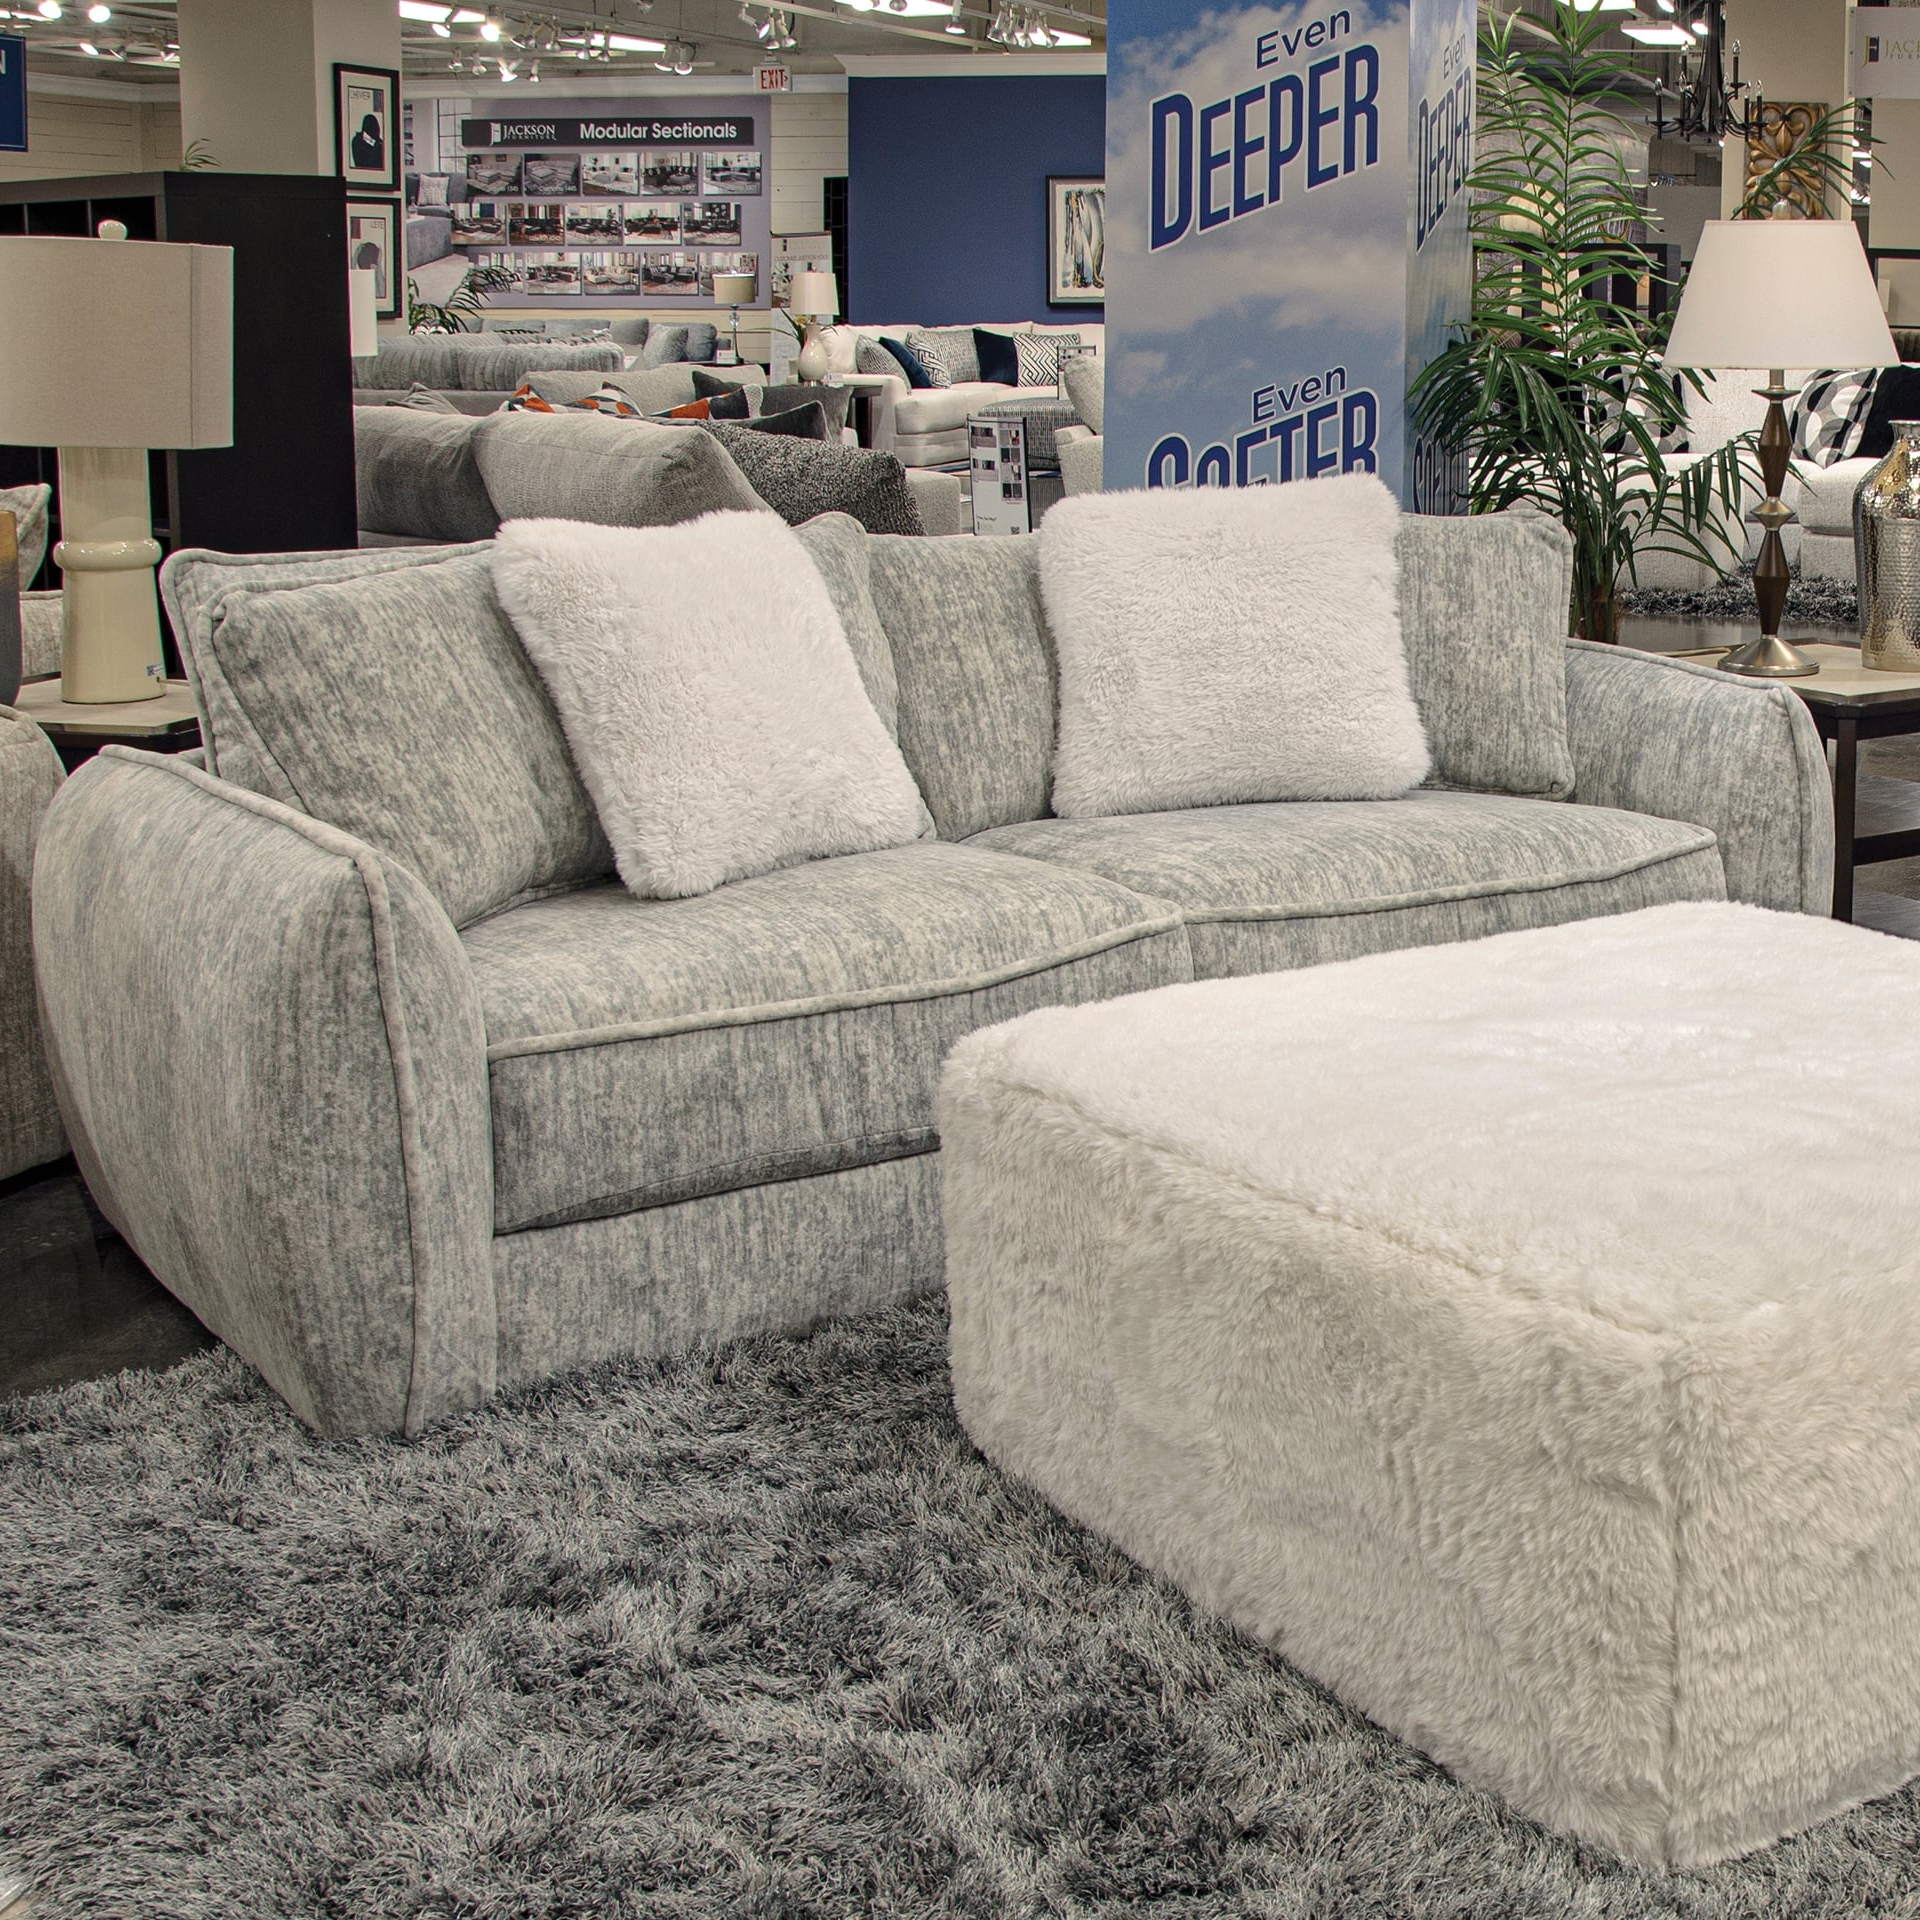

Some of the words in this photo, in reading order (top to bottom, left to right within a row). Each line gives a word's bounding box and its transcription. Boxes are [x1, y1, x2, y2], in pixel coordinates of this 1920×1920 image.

[1256, 10, 1351, 70] Even
[1443, 33, 1466, 81] Even
[760, 69, 785, 89] EXIT
[503, 124, 555, 139] JACKSON
[580, 122, 648, 139] Modular
[652, 122, 737, 139] Sectionals
[1150, 44, 1380, 251] DEEPER
[1416, 66, 1471, 253] DEEPER
[1253, 366, 1346, 424] Even
